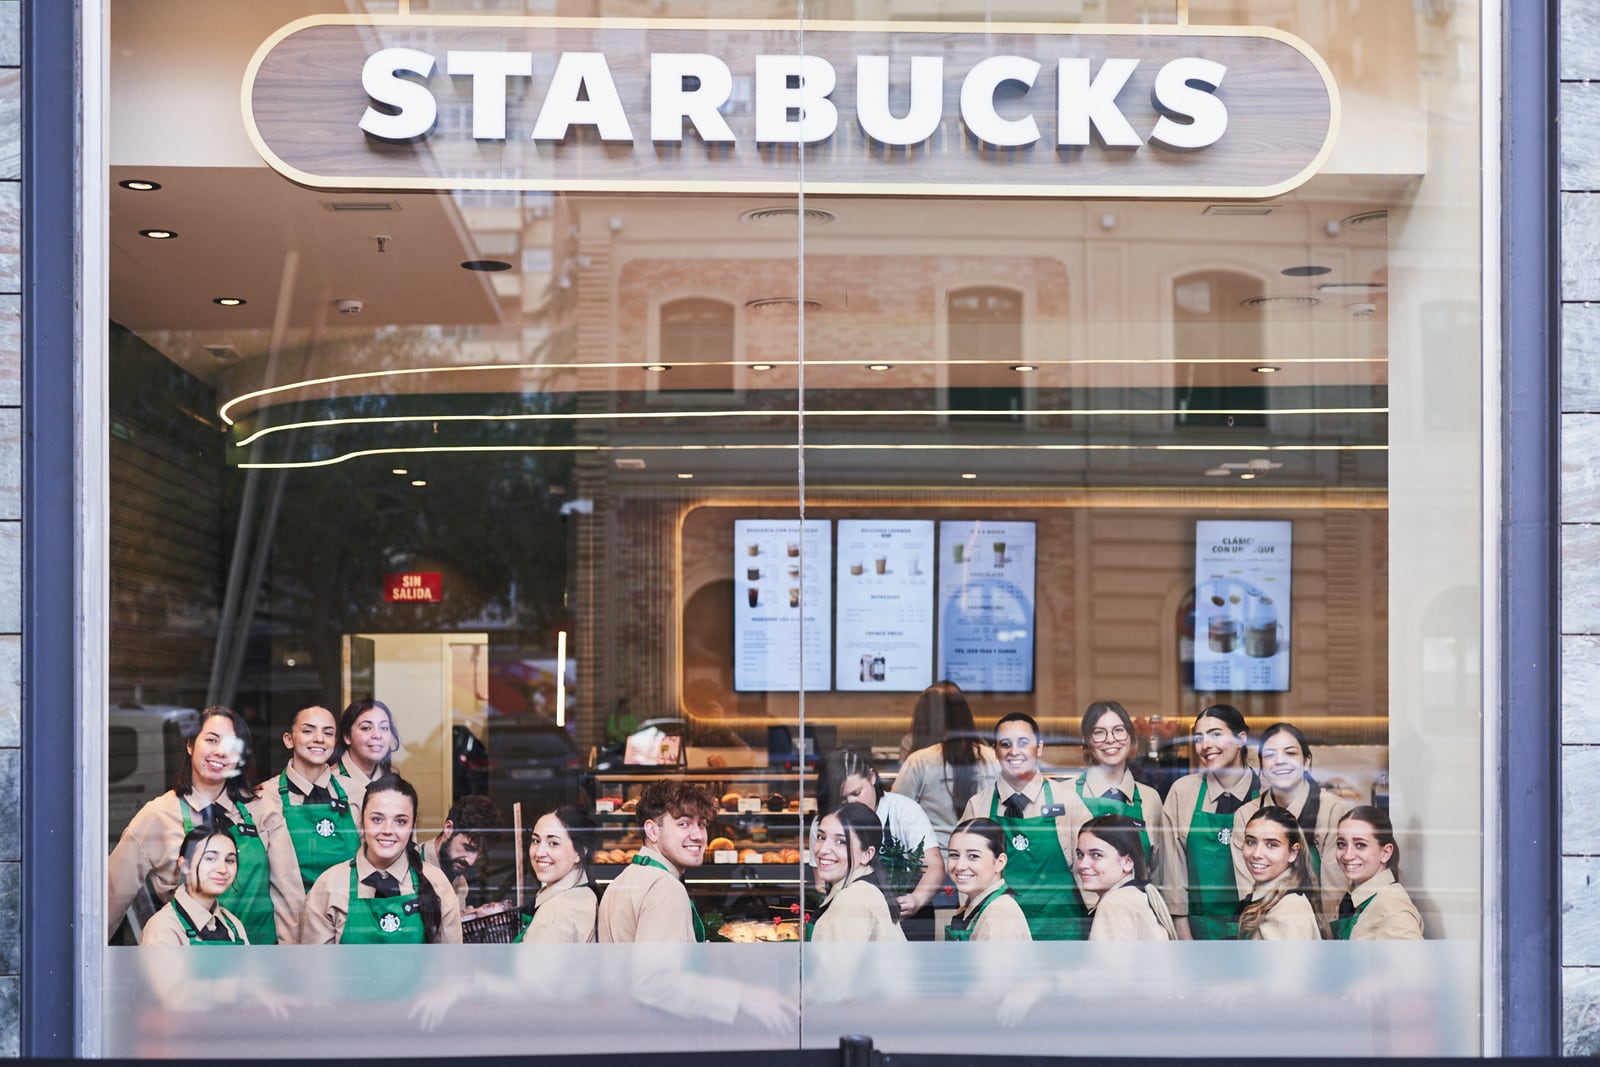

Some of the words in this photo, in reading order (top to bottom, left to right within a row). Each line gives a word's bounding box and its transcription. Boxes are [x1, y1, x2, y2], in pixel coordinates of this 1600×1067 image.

[357, 48, 1229, 149] STARBUCKS
[1222, 535, 1255, 545] CLÁSIC
[1212, 545, 1230, 553] CON
[402, 575, 421, 587] SIN
[392, 587, 432, 600] SALIDA
